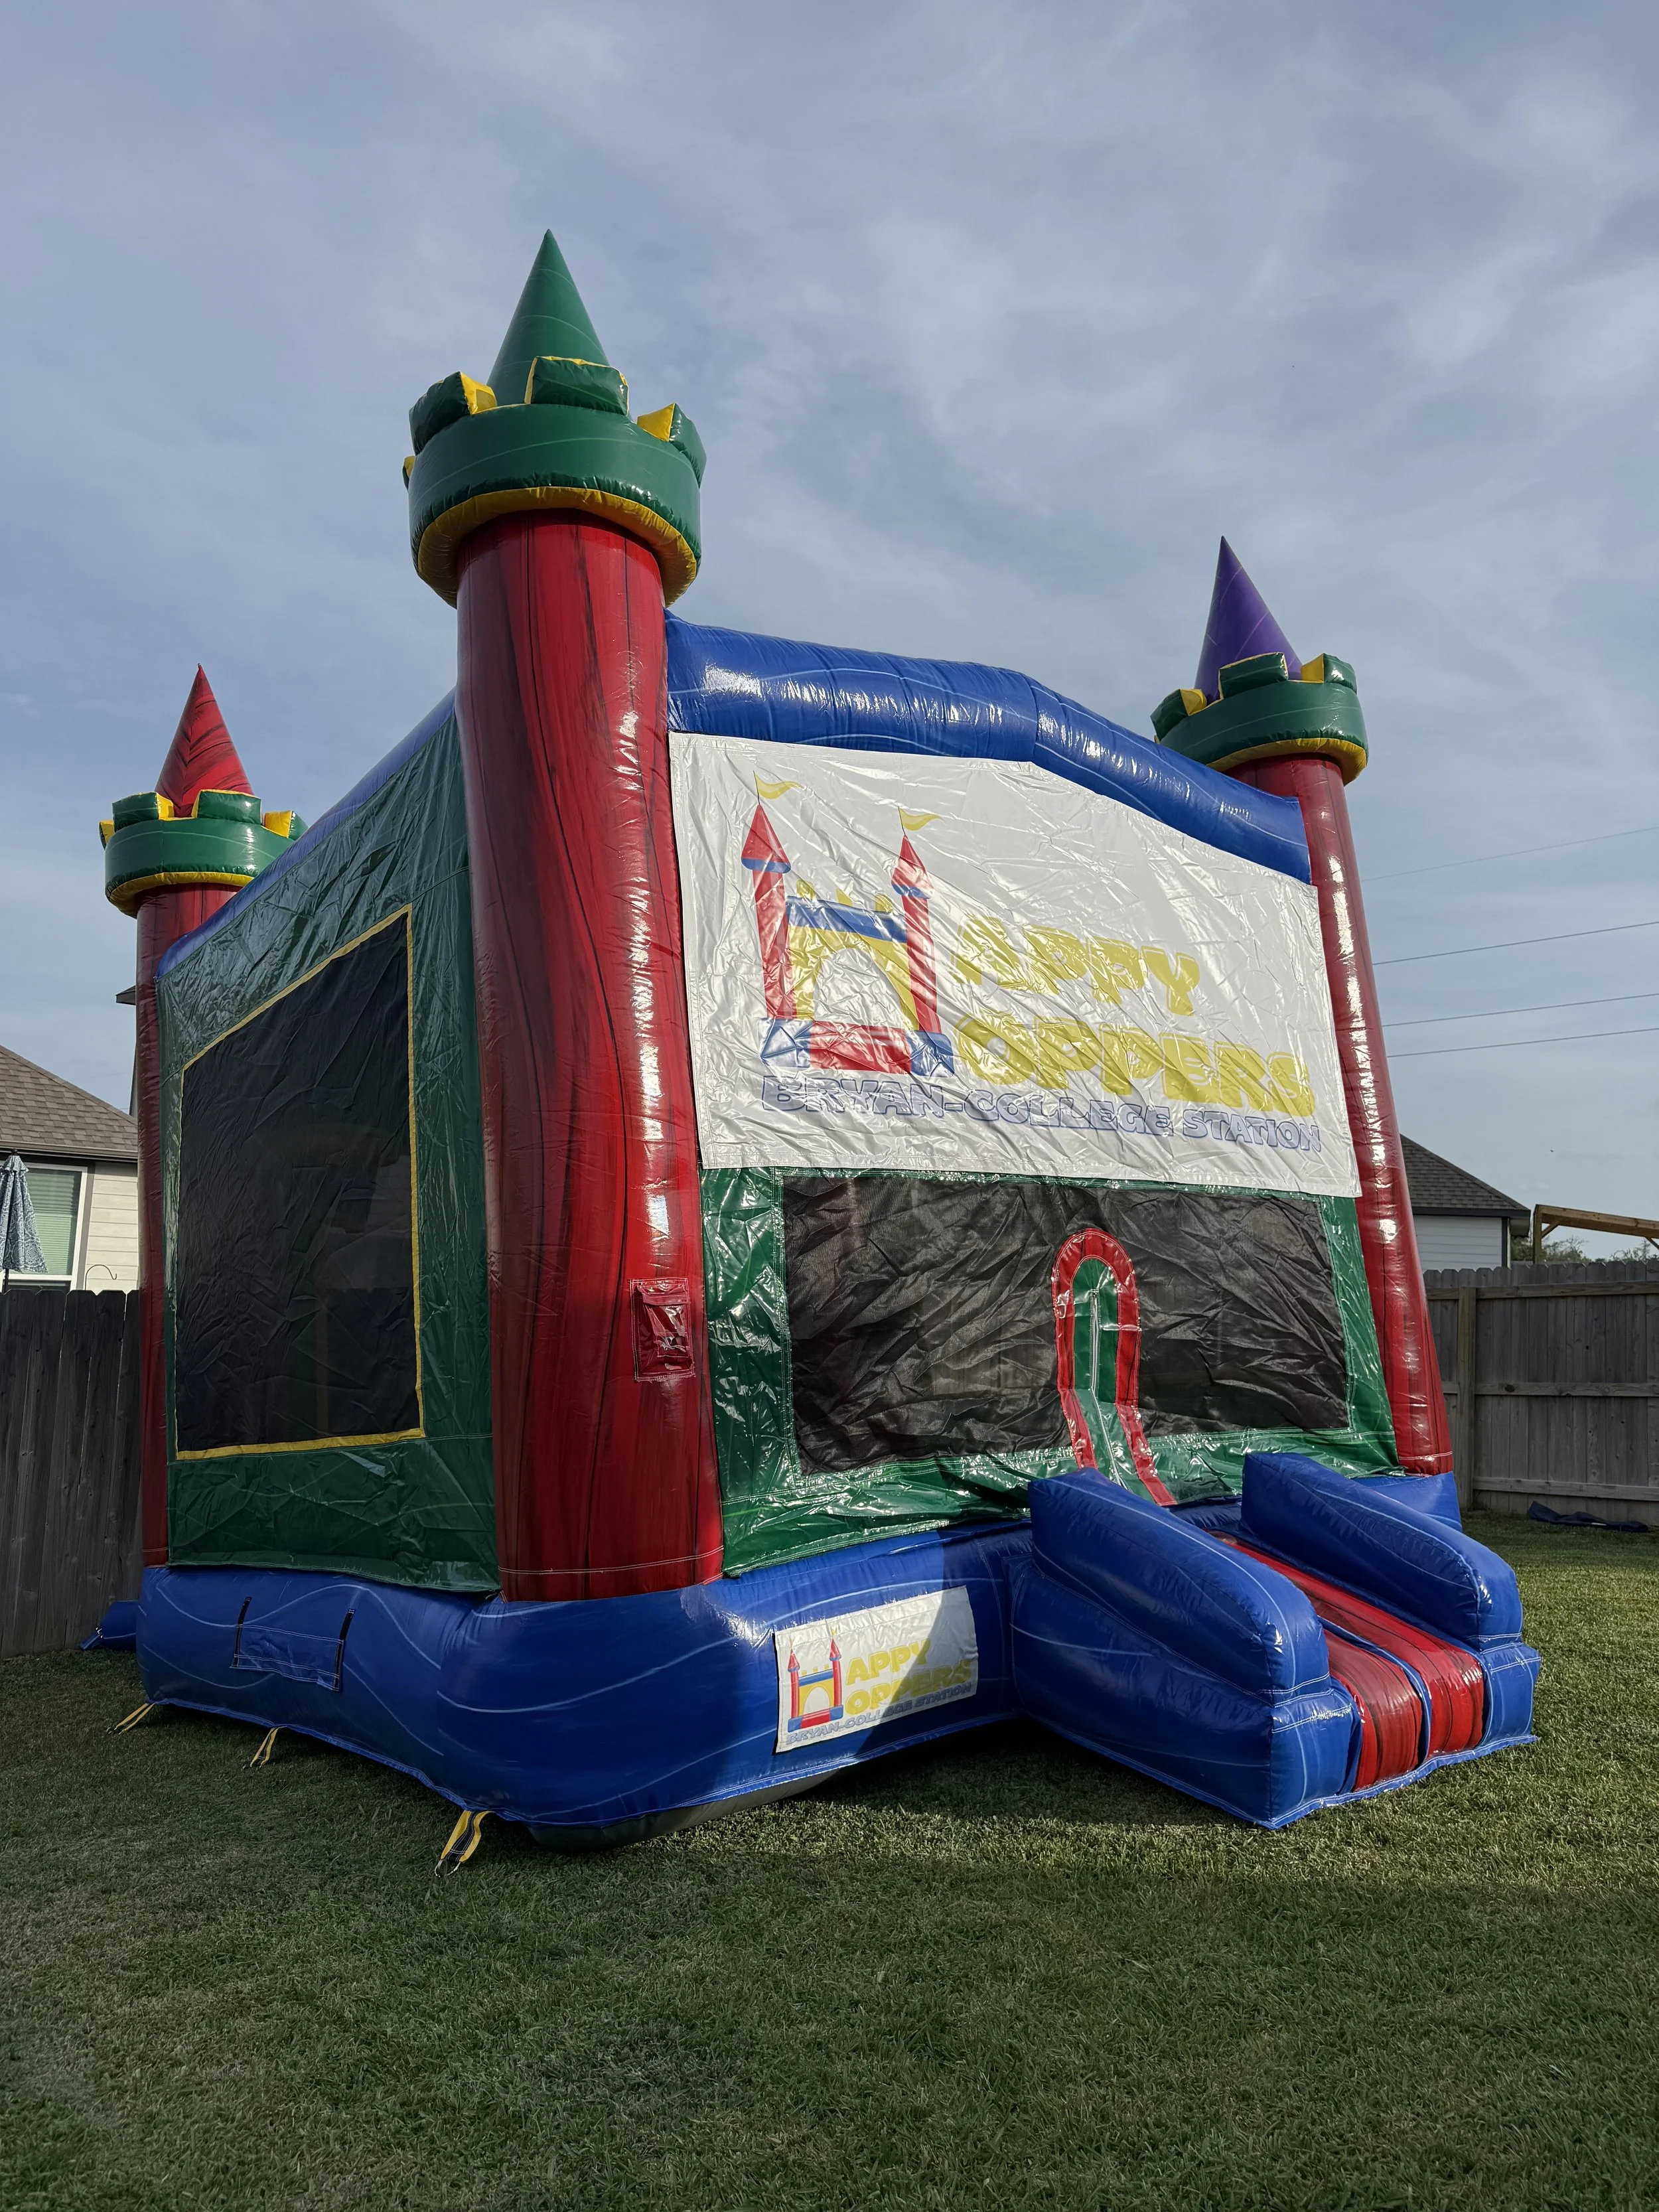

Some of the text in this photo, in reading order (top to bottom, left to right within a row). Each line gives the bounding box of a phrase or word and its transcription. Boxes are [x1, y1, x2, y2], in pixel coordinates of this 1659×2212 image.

[761, 1075, 1322, 1151] BRYAN-COLLEGE STATION
[915, 1683, 972, 1708] STATION
